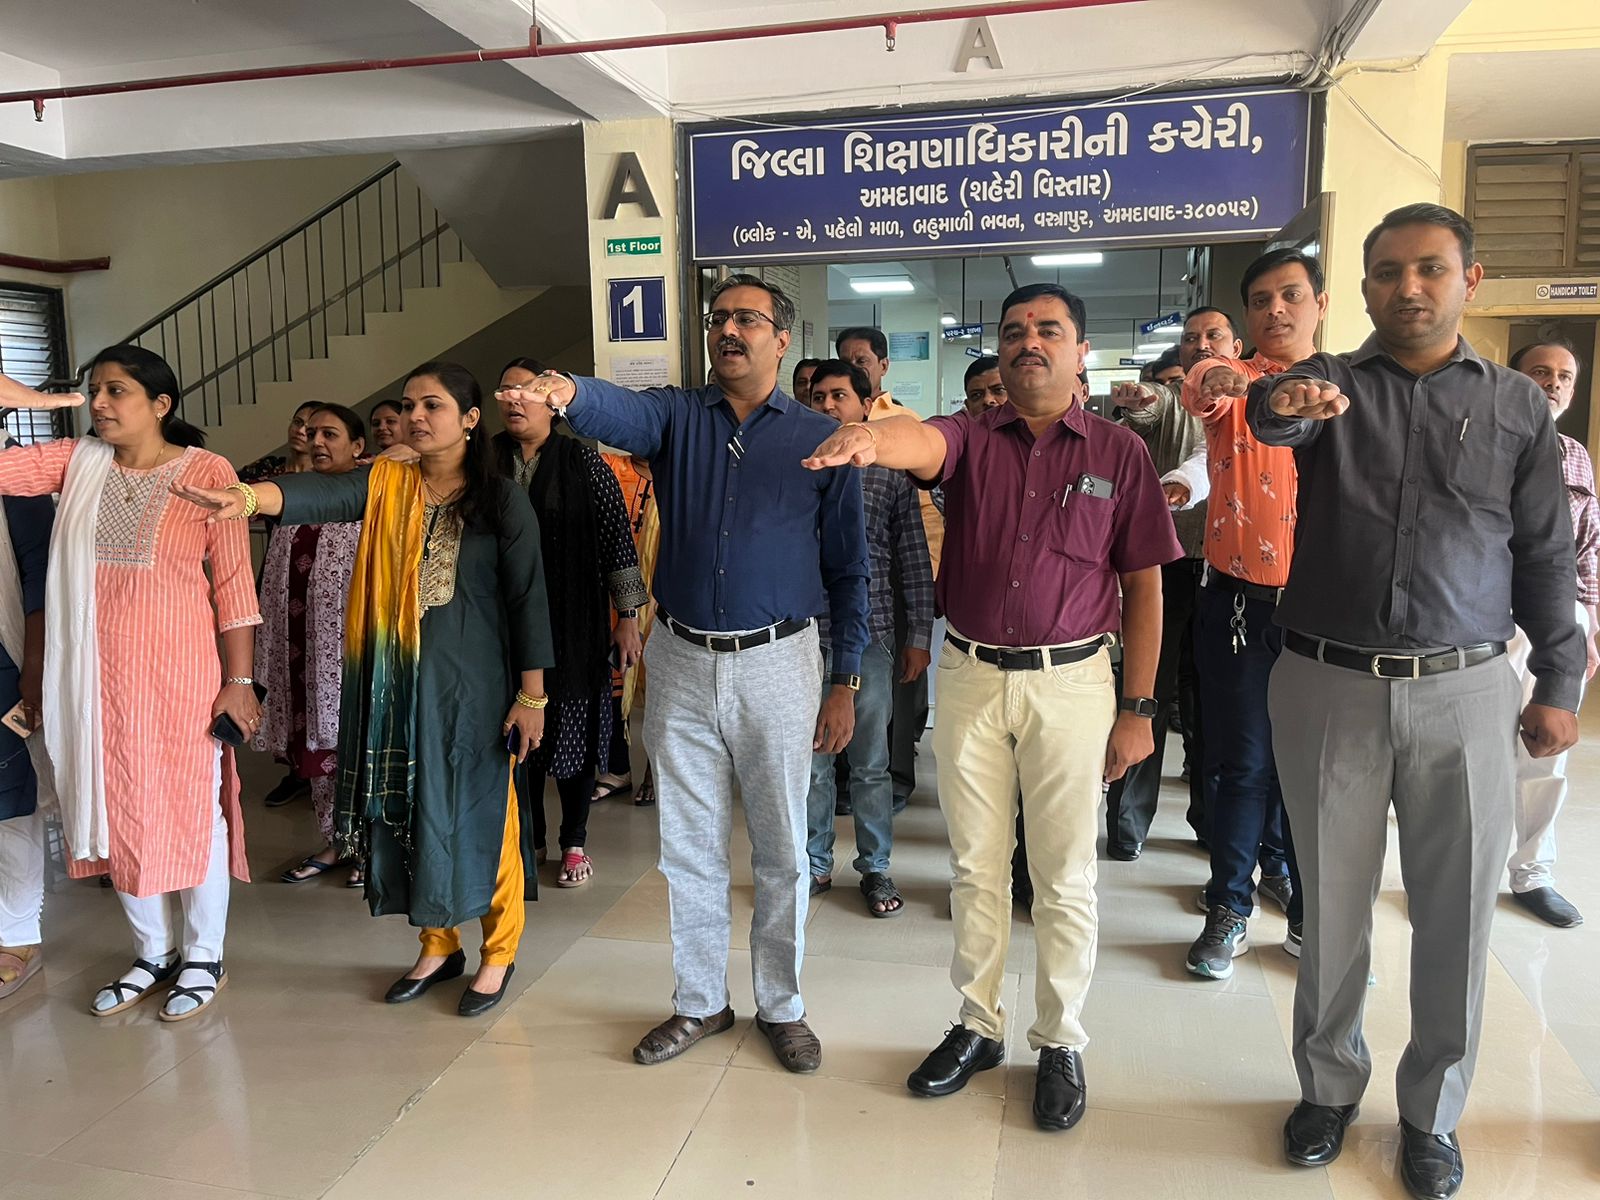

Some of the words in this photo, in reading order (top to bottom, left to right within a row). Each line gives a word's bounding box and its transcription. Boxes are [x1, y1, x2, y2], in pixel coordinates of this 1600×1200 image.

[952, 15, 1004, 73] A
[731, 138, 825, 180] જિલ્લા
[844, 111, 1129, 175] શિક્ષણાધિકારીની
[1147, 101, 1263, 155] કચેરી,
[603, 151, 662, 219] A
[860, 182, 949, 208] અમદાવાદ
[959, 169, 1023, 209] (શહેરી
[1033, 168, 1112, 201] વિસ્તાર)
[607, 242, 627, 253] 1st
[629, 240, 660, 251] Floor
[733, 221, 776, 247] (બ્લોક
[796, 218, 817, 243] એ,
[824, 215, 863, 239] પહેલો
[869, 220, 904, 239] માળ,
[912, 209, 974, 240] બહુમાળી
[980, 213, 1025, 232] ભવન,
[1033, 209, 1094, 233] વસ્ત્રાપુર,
[622, 285, 645, 334] 1
[1550, 286, 1577, 296] HANDICAP
[1578, 286, 1597, 295] TOILET
